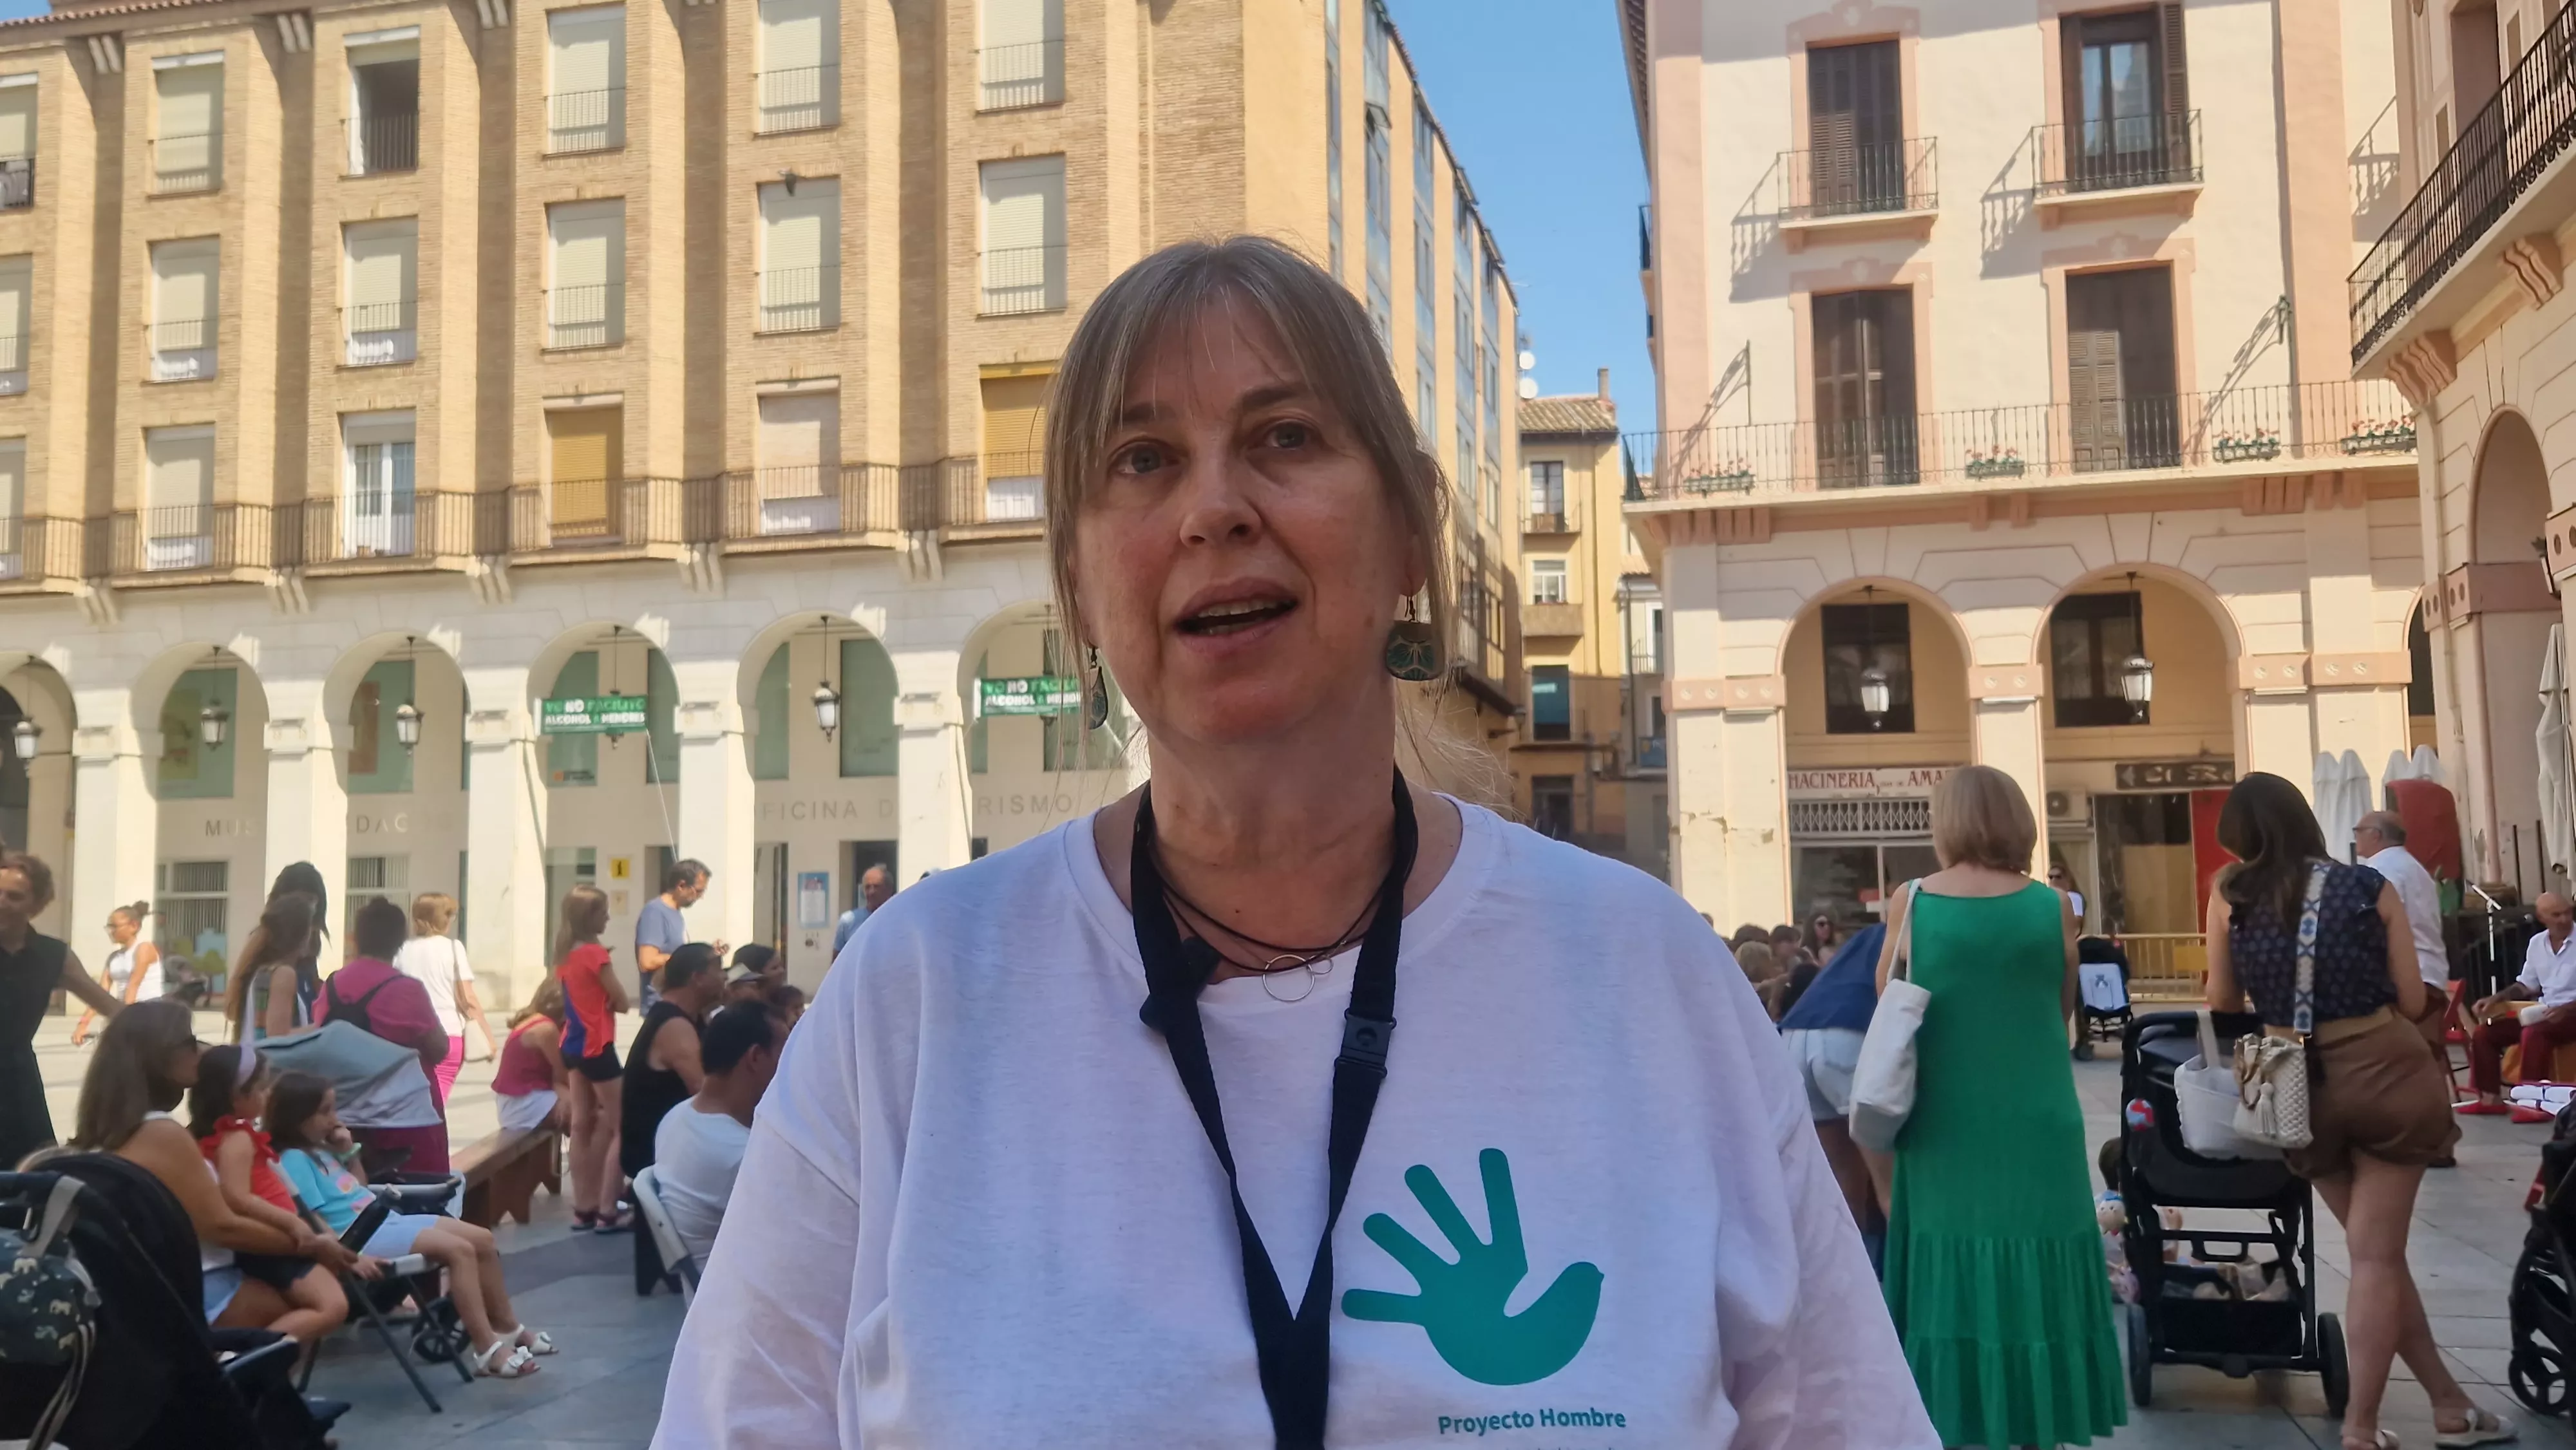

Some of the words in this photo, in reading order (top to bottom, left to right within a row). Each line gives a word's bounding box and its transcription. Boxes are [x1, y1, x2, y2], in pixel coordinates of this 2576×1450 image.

[1007, 679, 1028, 693] NO
[565, 699, 585, 713] NO
[985, 695, 1036, 706] ALCOHOL
[545, 713, 592, 725] ALCOHOL
[1908, 770, 1951, 786] AMA
[1438, 1410, 1535, 1436] Proyecto
[1540, 1407, 1627, 1428] Hombre
